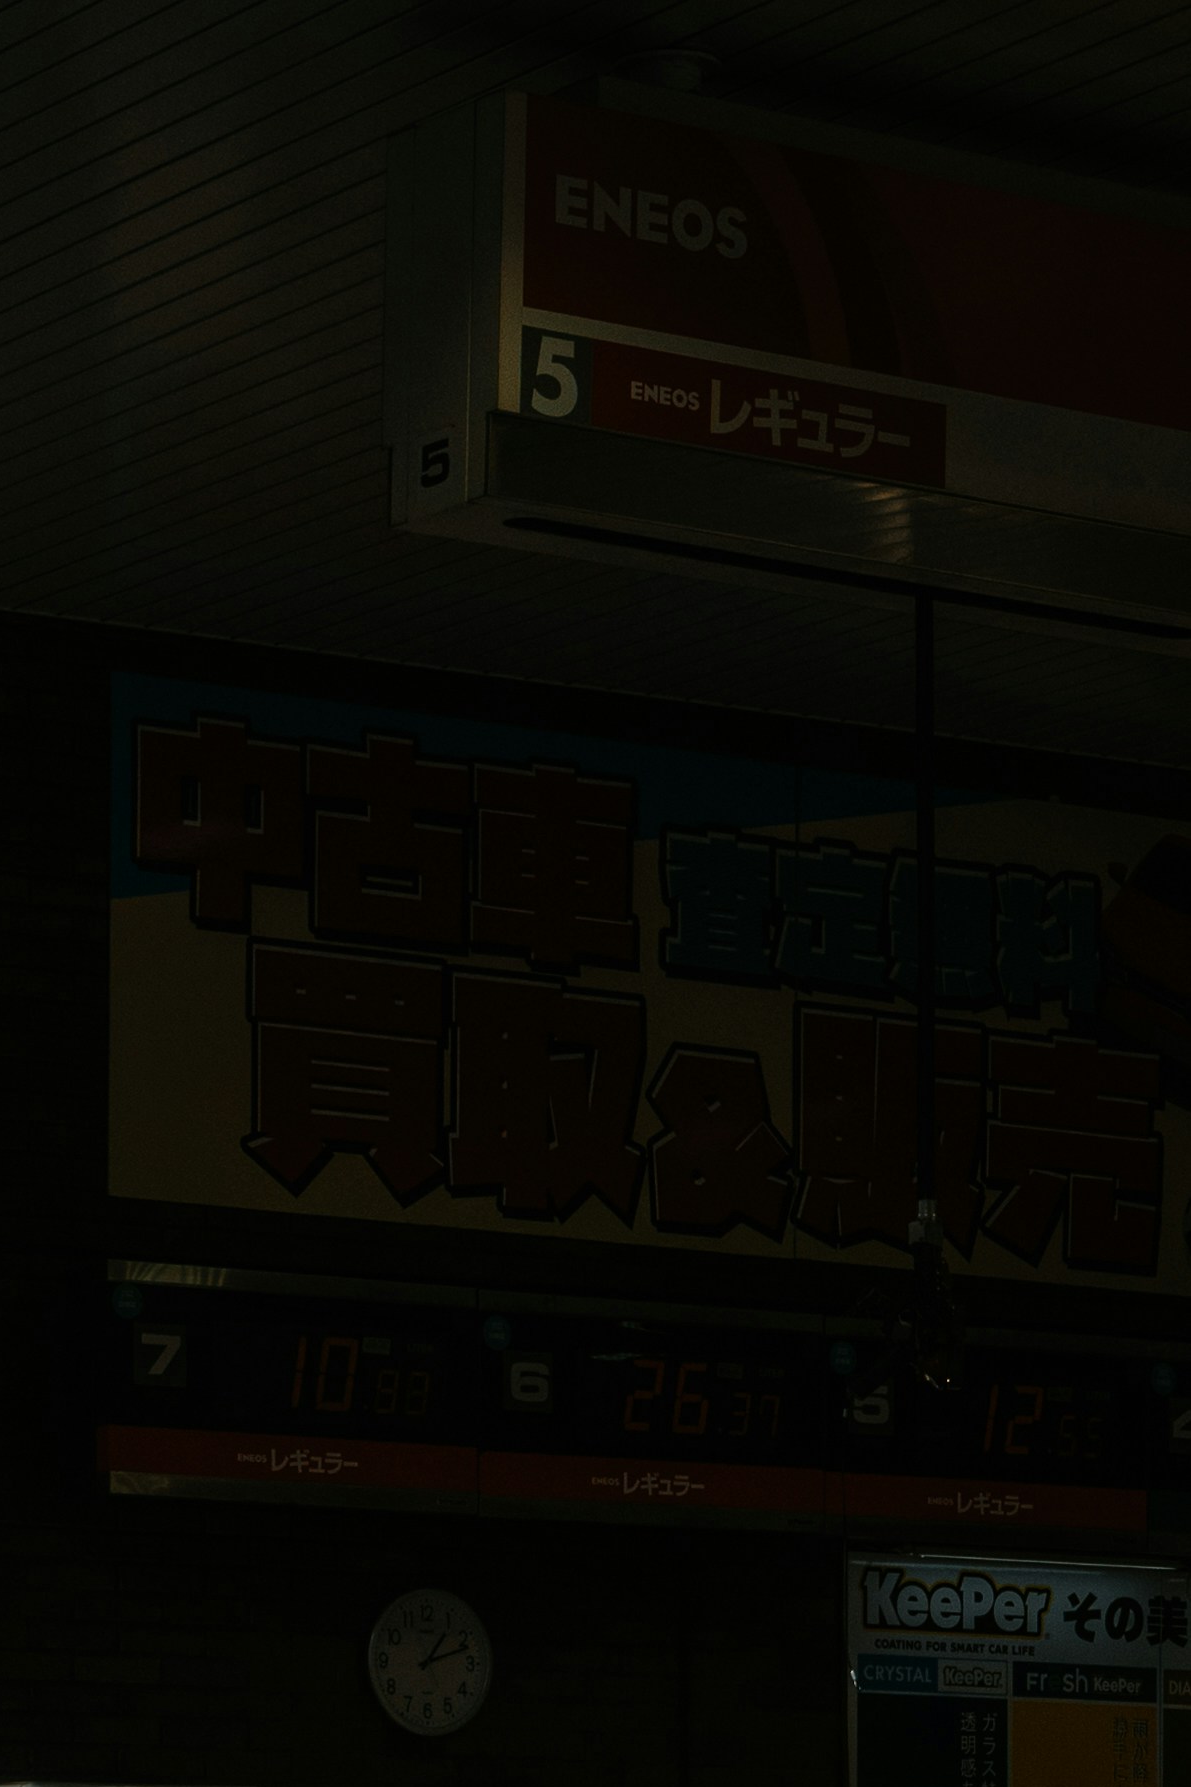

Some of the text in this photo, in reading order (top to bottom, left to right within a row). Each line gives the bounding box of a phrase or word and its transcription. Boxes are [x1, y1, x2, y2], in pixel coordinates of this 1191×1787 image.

[554, 174, 748, 260] ENEOS
[531, 336, 579, 419] 5
[630, 378, 911, 459] ENEOS レギュラー
[421, 439, 450, 488] 5
[133, 716, 1103, 1014] 中古車 査定無料
[243, 938, 1166, 1278] 買取&販売
[140, 1333, 182, 1375] 7
[510, 1362, 550, 1403] 6
[852, 1384, 890, 1424] 5
[237, 1448, 359, 1475] ENEOS レギュラー
[591, 1471, 706, 1497] ENEOS レギュラー
[956, 1490, 1034, 1516] レギュラー
[420, 1604, 434, 1622] 12
[861, 1568, 1188, 1647] KeePer その美
[403, 1610, 414, 1628] 11
[445, 1612, 451, 1629] 1
[387, 1628, 401, 1645] 10
[459, 1630, 468, 1648] 2
[875, 1639, 1035, 1656] COATING FOR SMART CAR LIFE
[378, 1652, 388, 1669] 9
[465, 1655, 475, 1672] 3
[863, 1665, 1002, 1687] CRYSTAL KeePer
[1093, 1675, 1142, 1694] KeePer
[387, 1678, 396, 1695] 8
[458, 1681, 467, 1698] 4
[404, 1696, 412, 1712] 7
[423, 1702, 433, 1719] 6
[443, 1697, 452, 1714] 5
